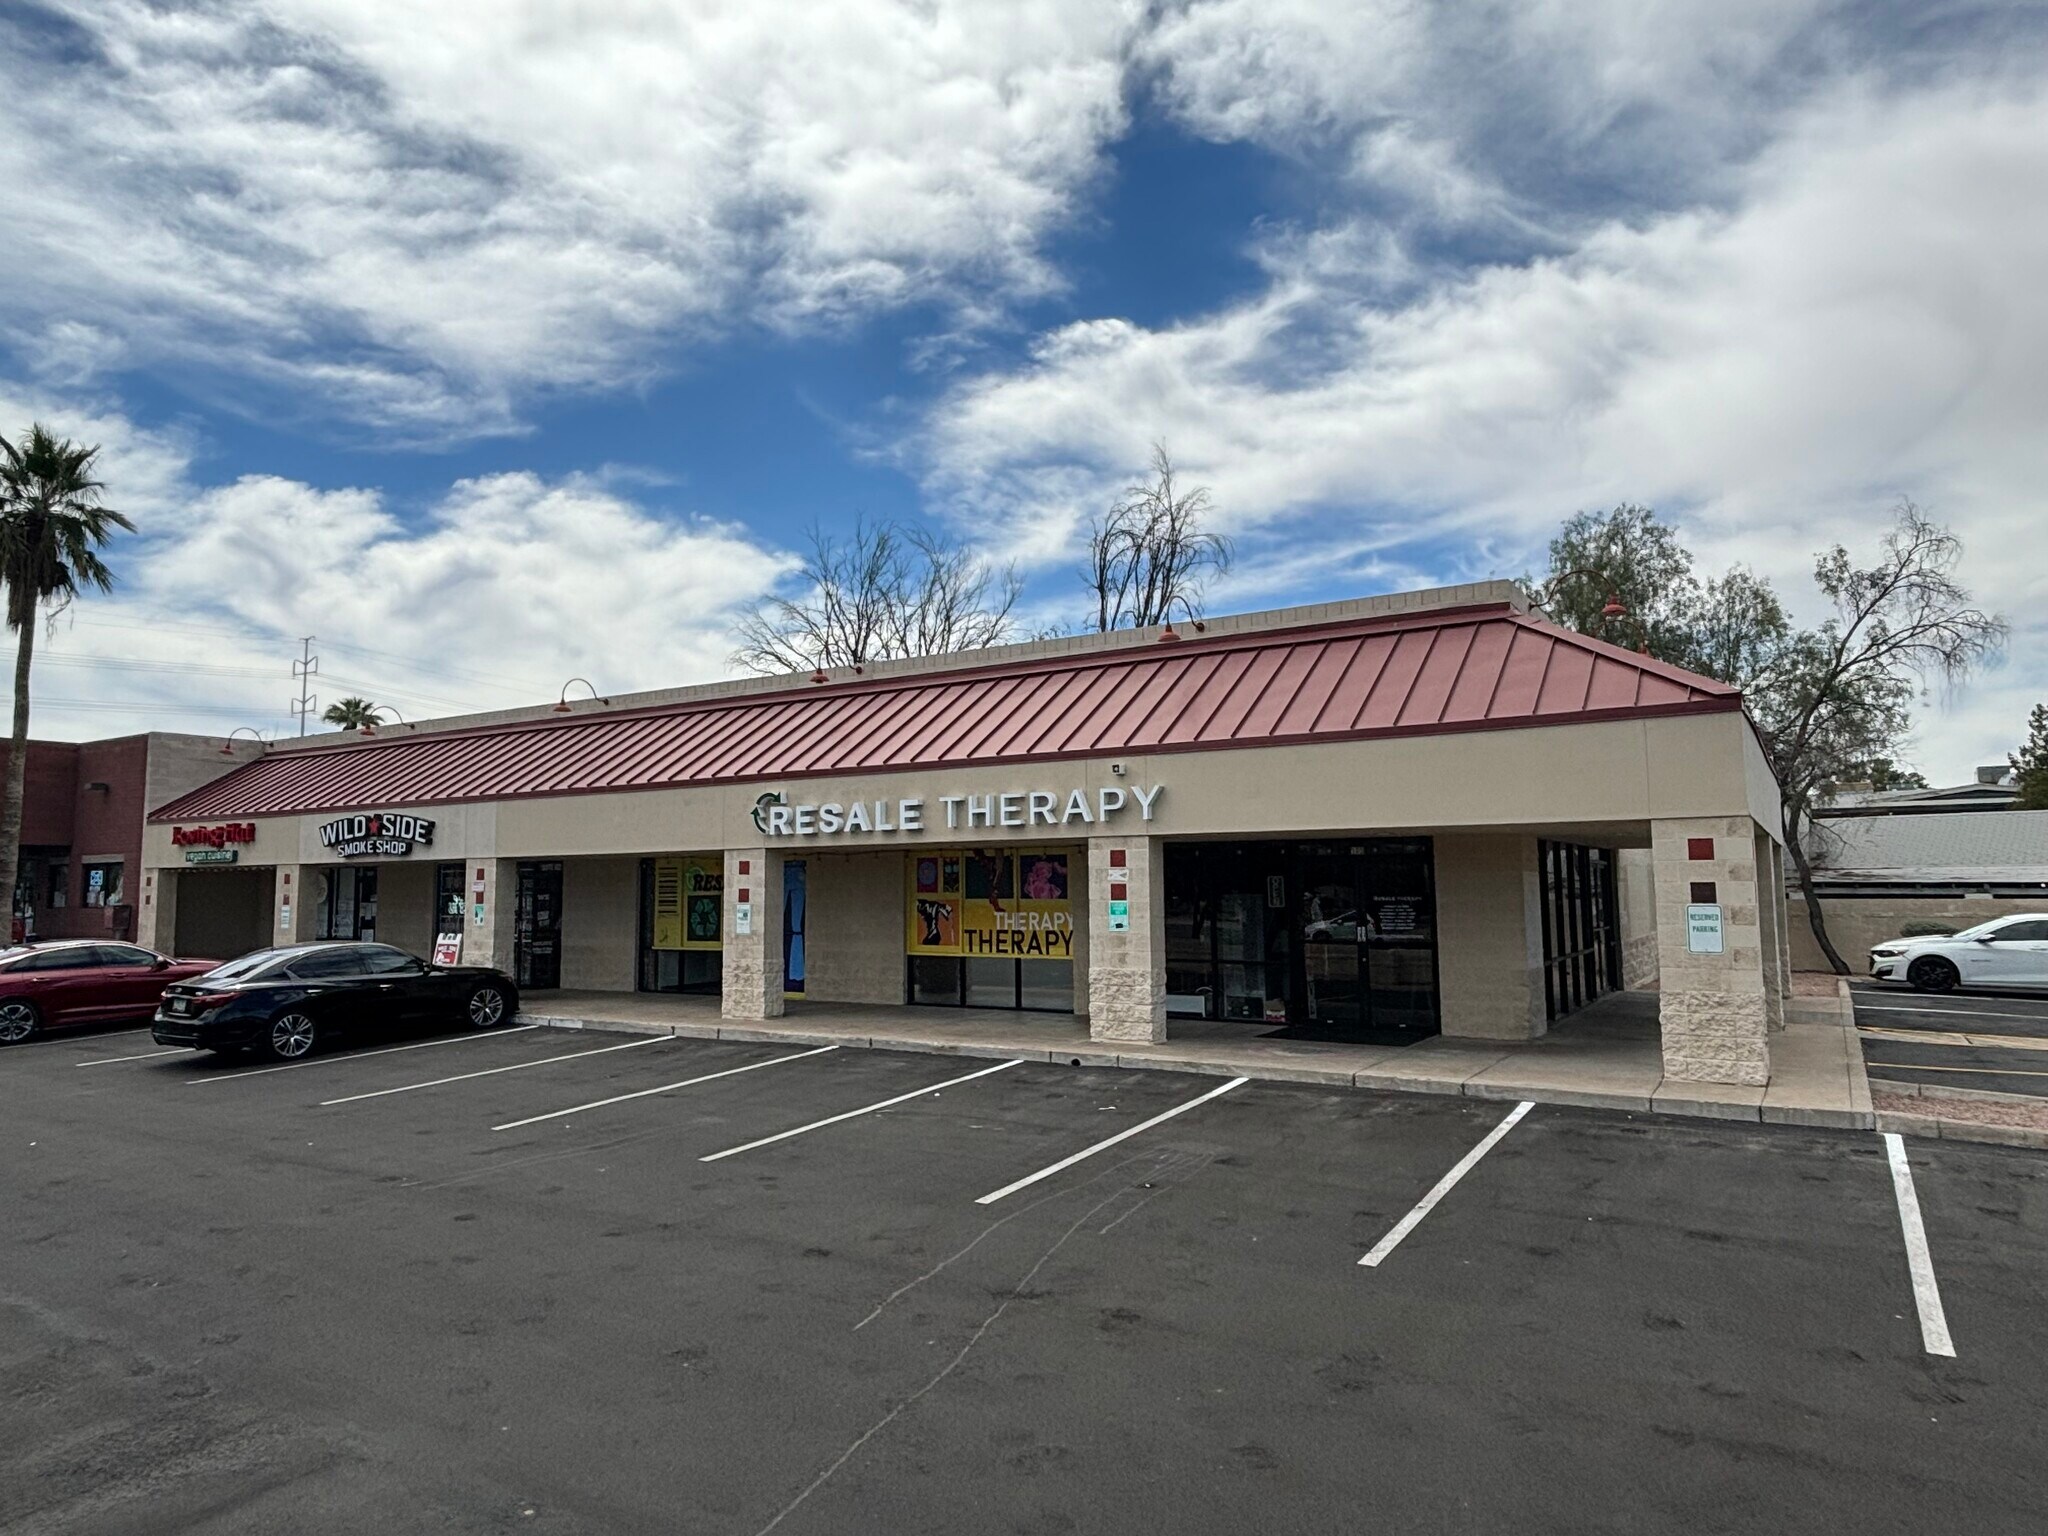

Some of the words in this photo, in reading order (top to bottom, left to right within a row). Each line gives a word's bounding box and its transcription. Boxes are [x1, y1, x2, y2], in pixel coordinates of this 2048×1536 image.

[769, 799, 923, 836] RESALE
[938, 784, 1165, 829] THERAPY
[319, 815, 367, 847] WILD
[381, 813, 433, 844] SIDE
[186, 852, 207, 864] vegan
[207, 851, 232, 861] cuisine
[338, 840, 374, 857] SMOKE
[375, 840, 407, 855] SHOP
[693, 873, 724, 892] RES
[994, 911, 1074, 931] THERAPY
[1690, 913, 1719, 921] RESERVED
[1692, 925, 1719, 933] PARKING
[964, 929, 1074, 956] THERAPY
